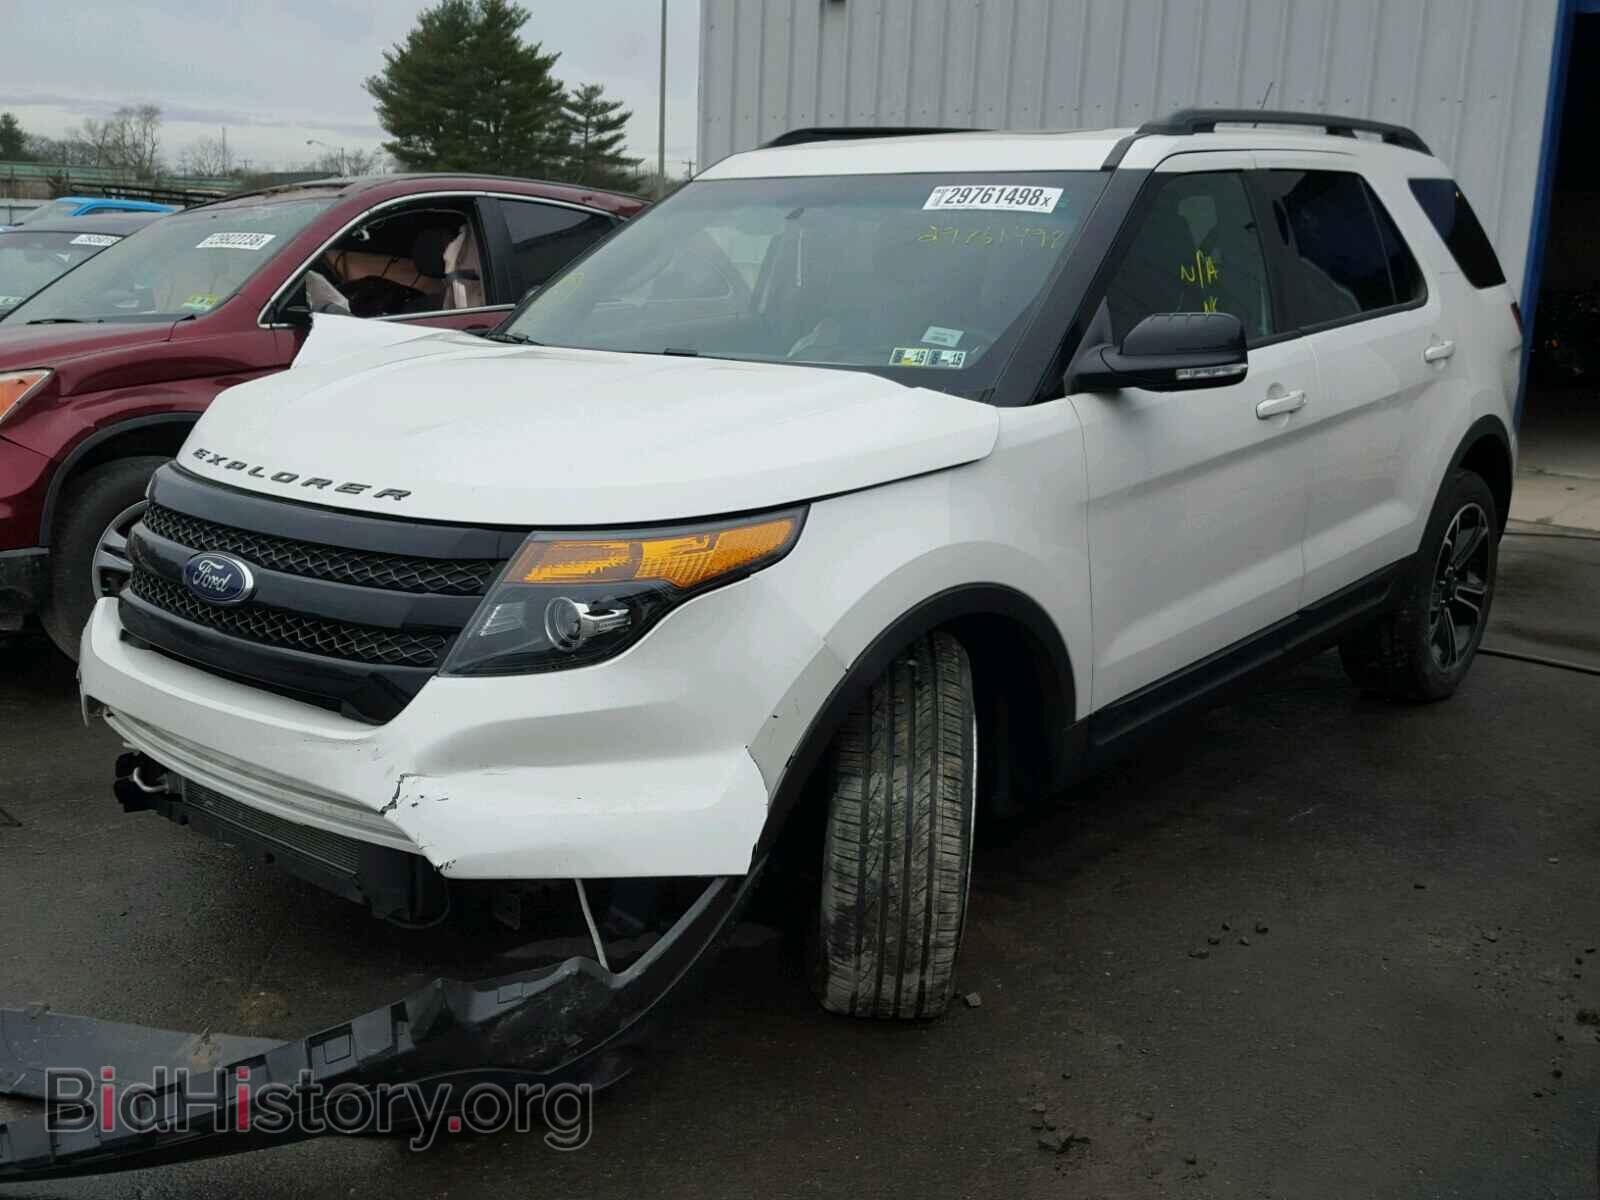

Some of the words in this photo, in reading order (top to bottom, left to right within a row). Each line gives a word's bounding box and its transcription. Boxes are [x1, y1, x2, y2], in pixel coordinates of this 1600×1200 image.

[1180, 250, 1218, 288] N/A
[193, 448, 412, 501] EXPLORER
[192, 560, 232, 592] Ford
